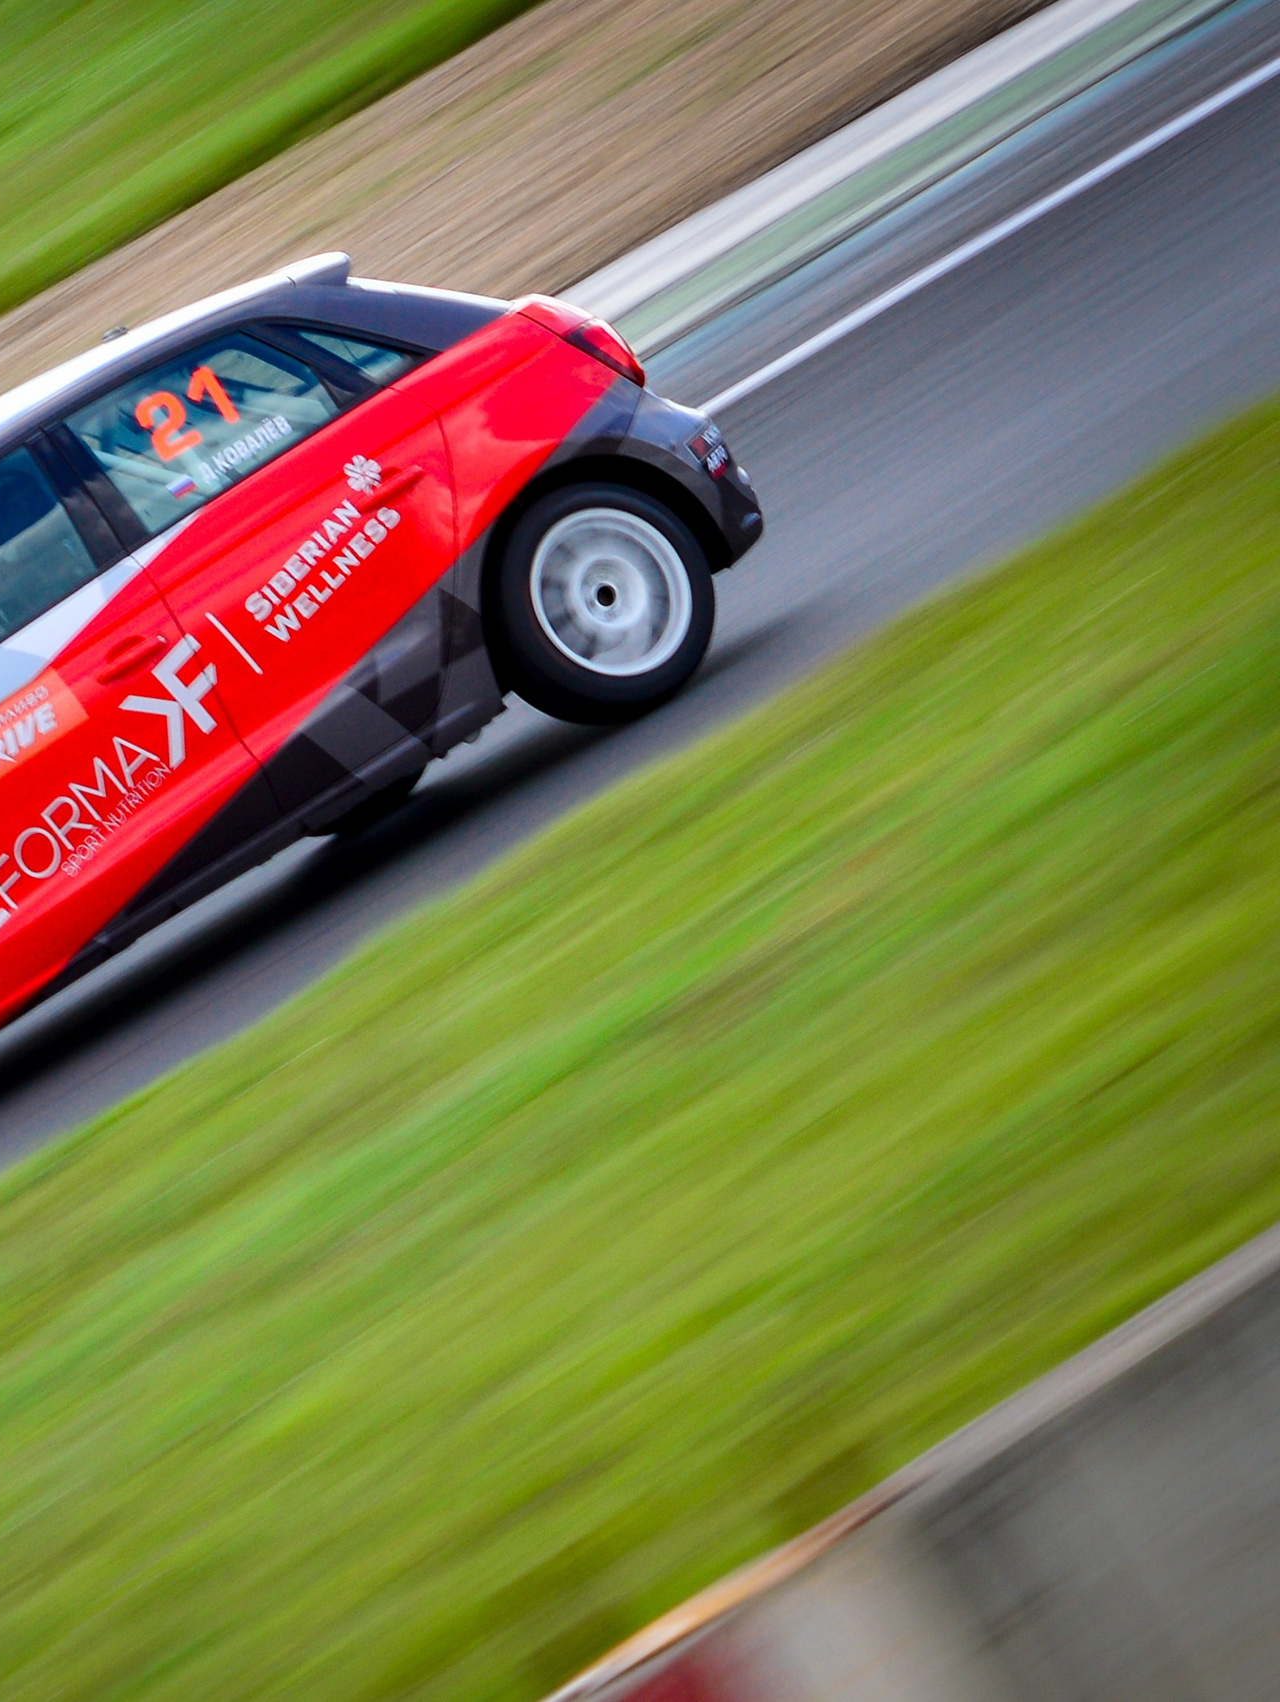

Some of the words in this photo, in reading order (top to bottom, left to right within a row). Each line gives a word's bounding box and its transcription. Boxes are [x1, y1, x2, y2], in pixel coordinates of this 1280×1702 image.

[135, 366, 240, 461] 21
[244, 499, 361, 622] SIBERIAN
[264, 507, 401, 642] WELLNESS
[61, 826, 107, 877] SPORT
[100, 762, 173, 834] NUTRITION
